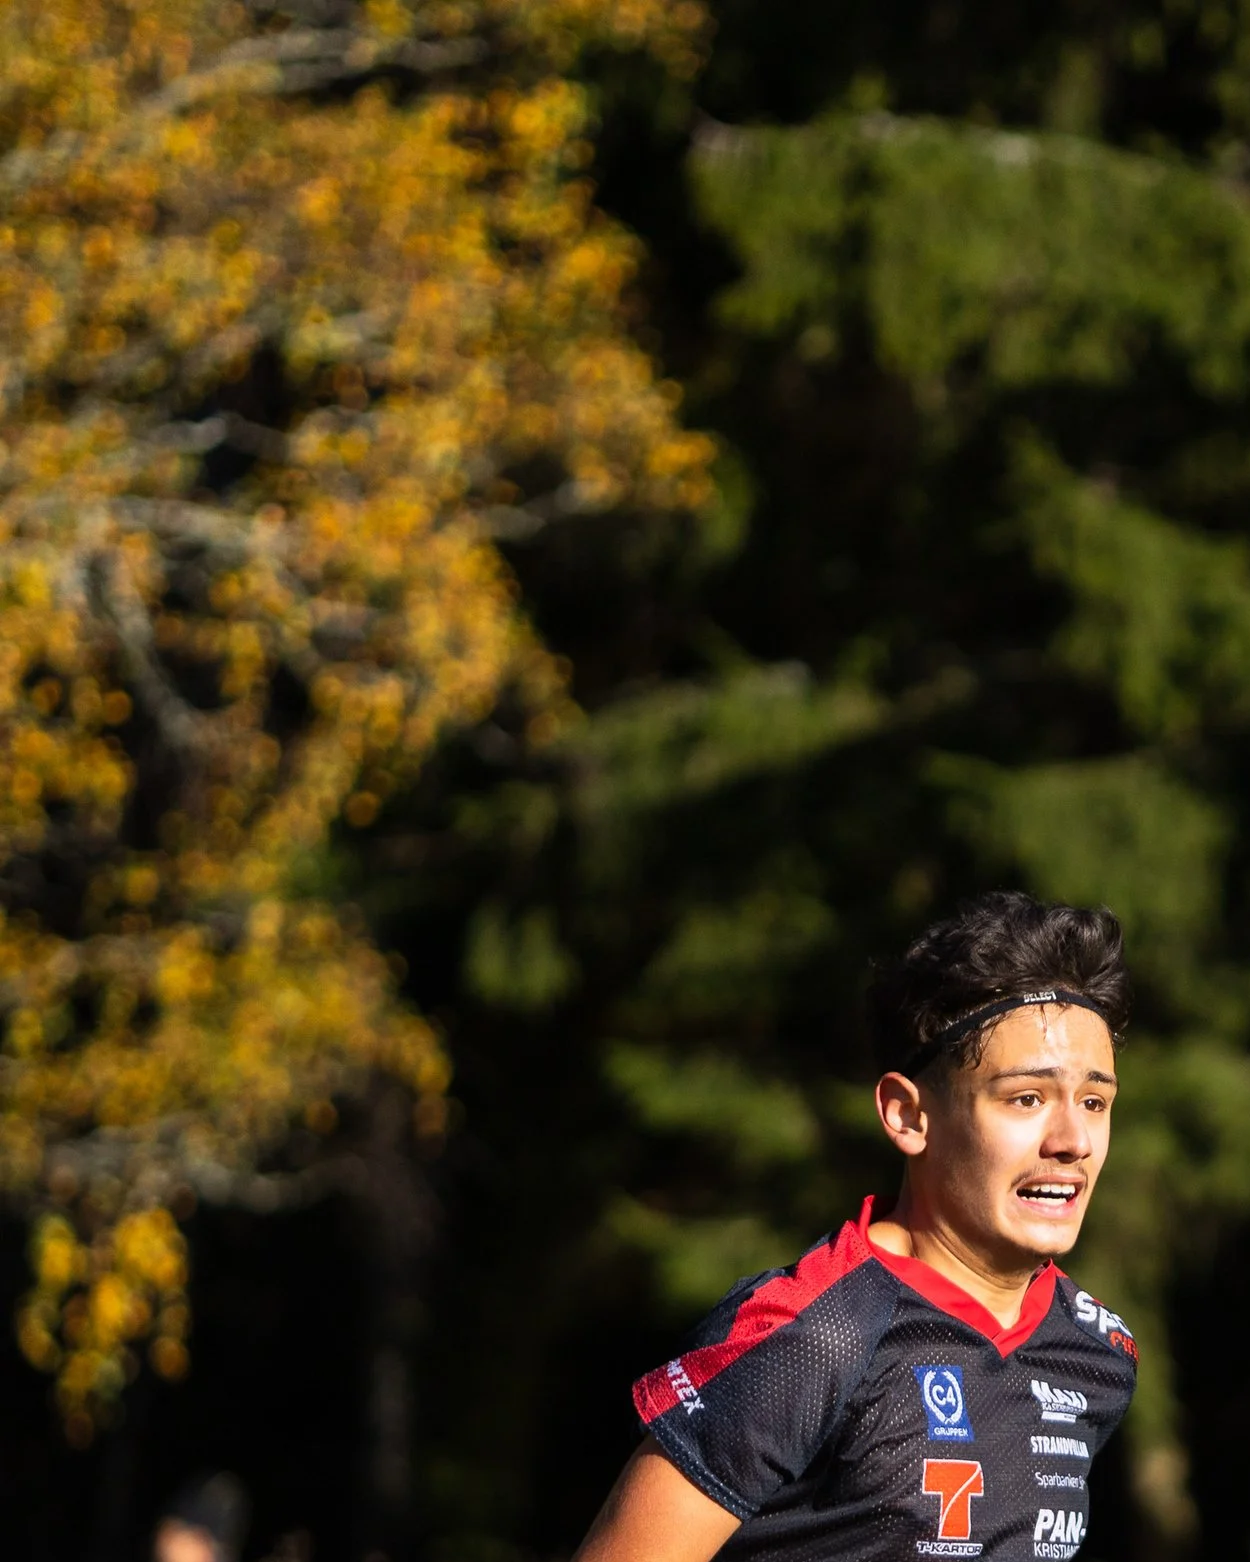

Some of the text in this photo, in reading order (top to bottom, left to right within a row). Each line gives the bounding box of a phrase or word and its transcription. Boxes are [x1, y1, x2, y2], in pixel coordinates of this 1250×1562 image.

[1023, 990, 1057, 1003] SELECT
[932, 1384, 957, 1407] C4
[1031, 1379, 1088, 1411] MAXI
[933, 1426, 969, 1437] GRUPPEN
[916, 1541, 984, 1555] T-KARTOR
